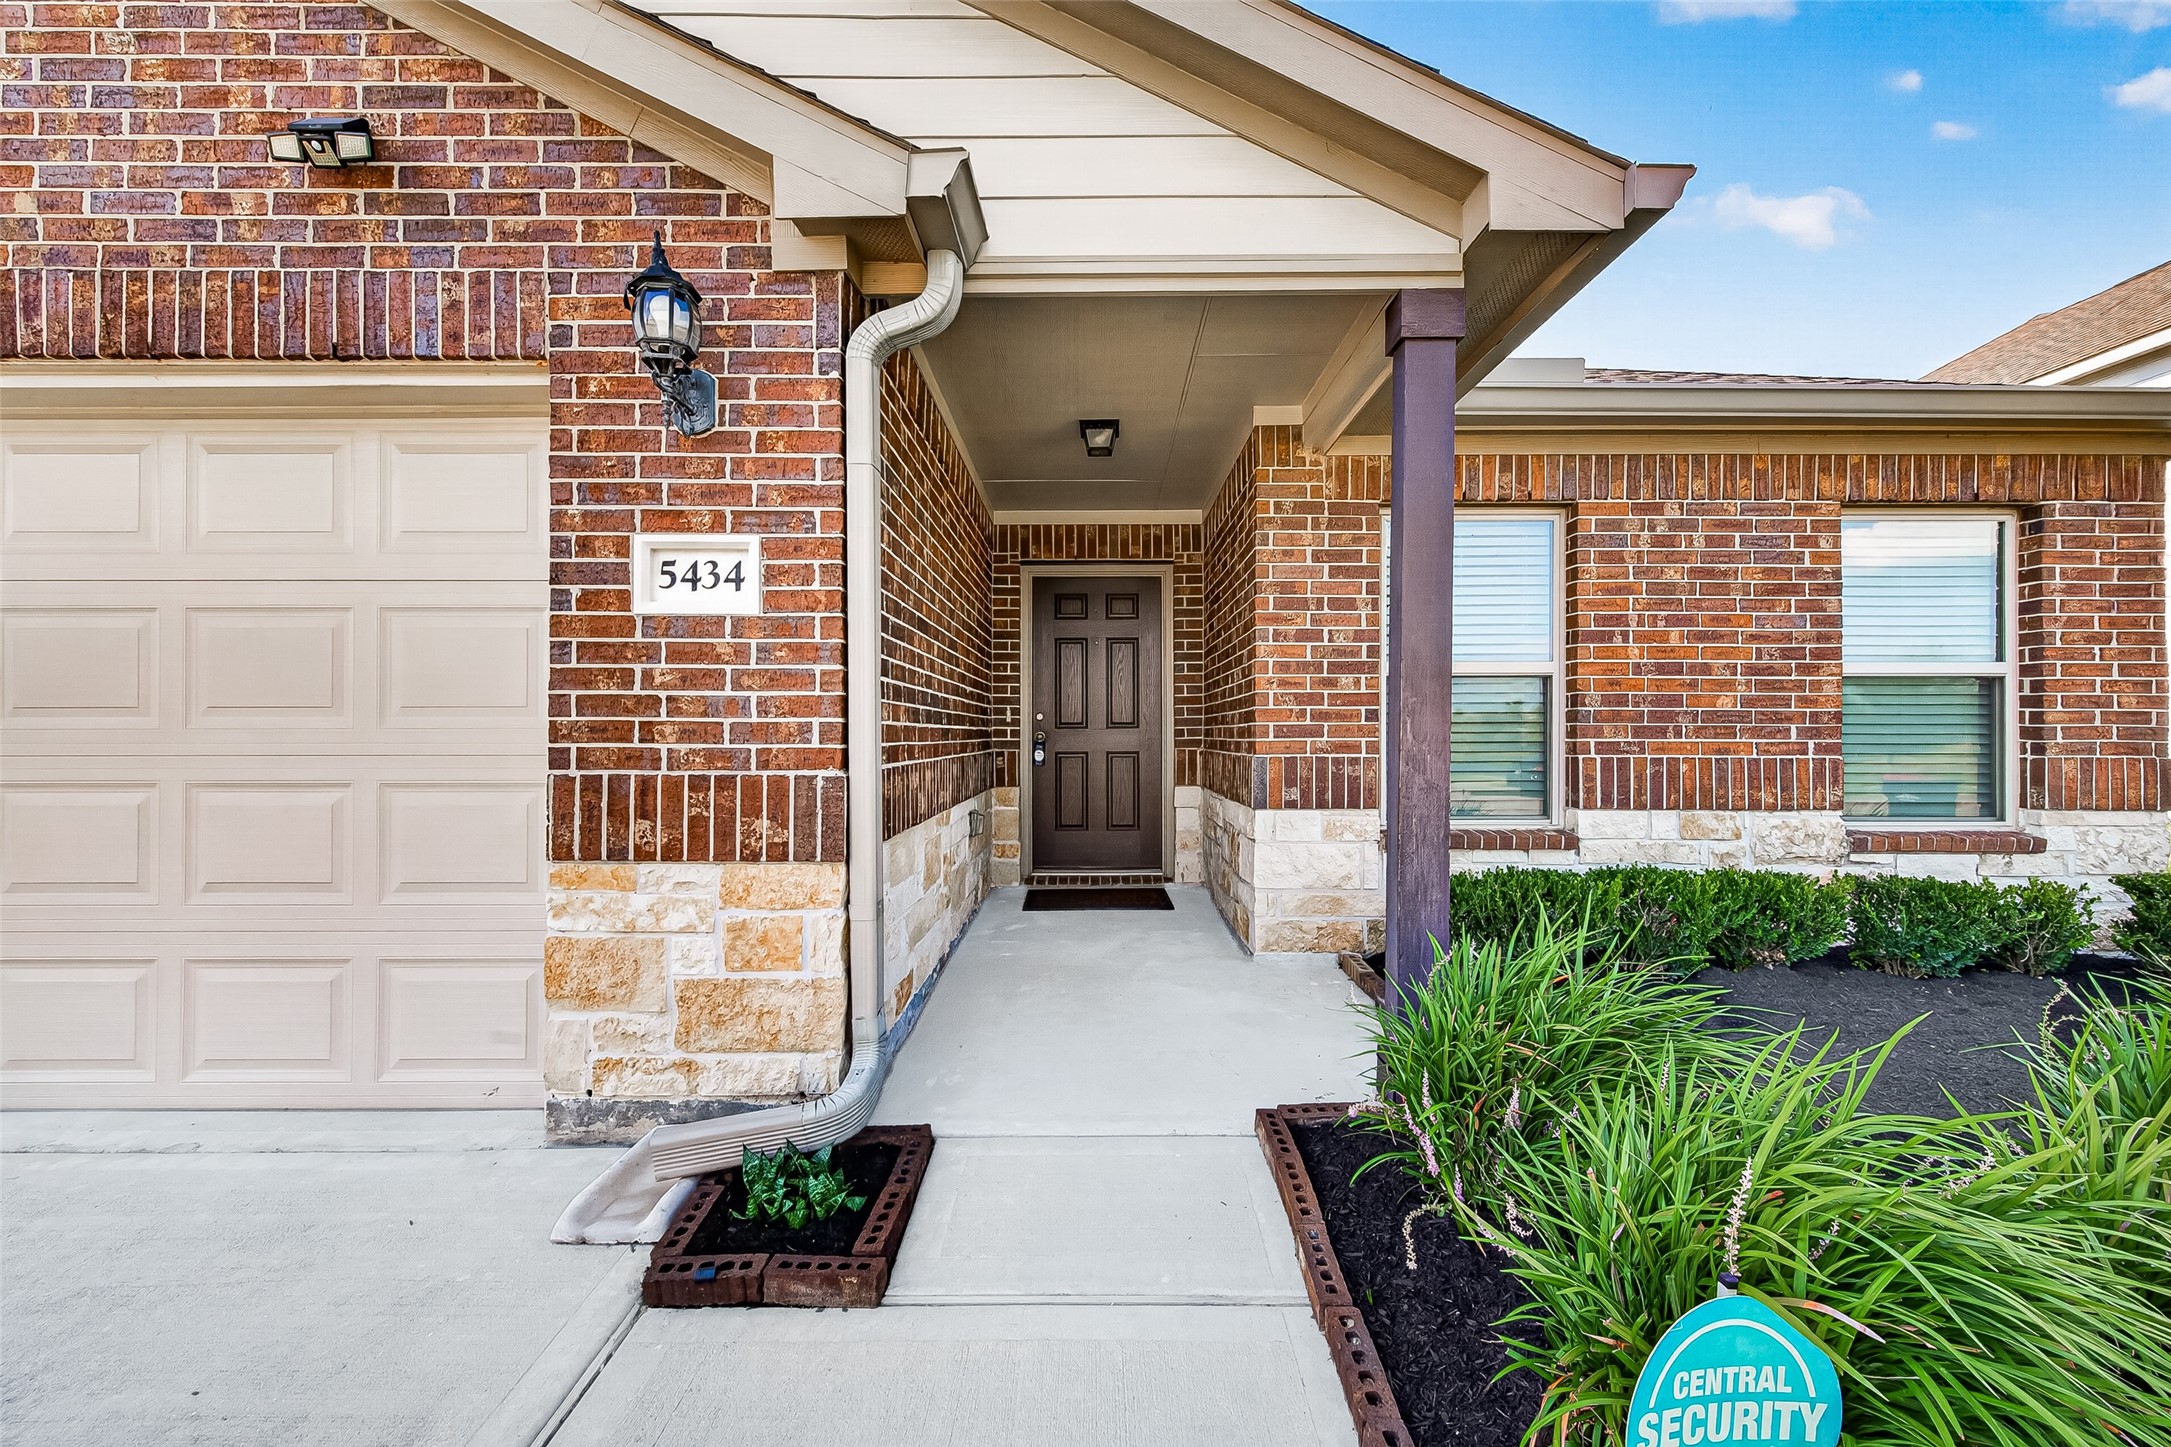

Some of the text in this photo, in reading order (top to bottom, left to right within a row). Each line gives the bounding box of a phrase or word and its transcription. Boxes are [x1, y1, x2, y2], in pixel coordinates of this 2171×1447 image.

[659, 559, 745, 592] 5434
[1673, 1365, 1792, 1400] CENTRAL
[1637, 1400, 1828, 1447] SECURITY
